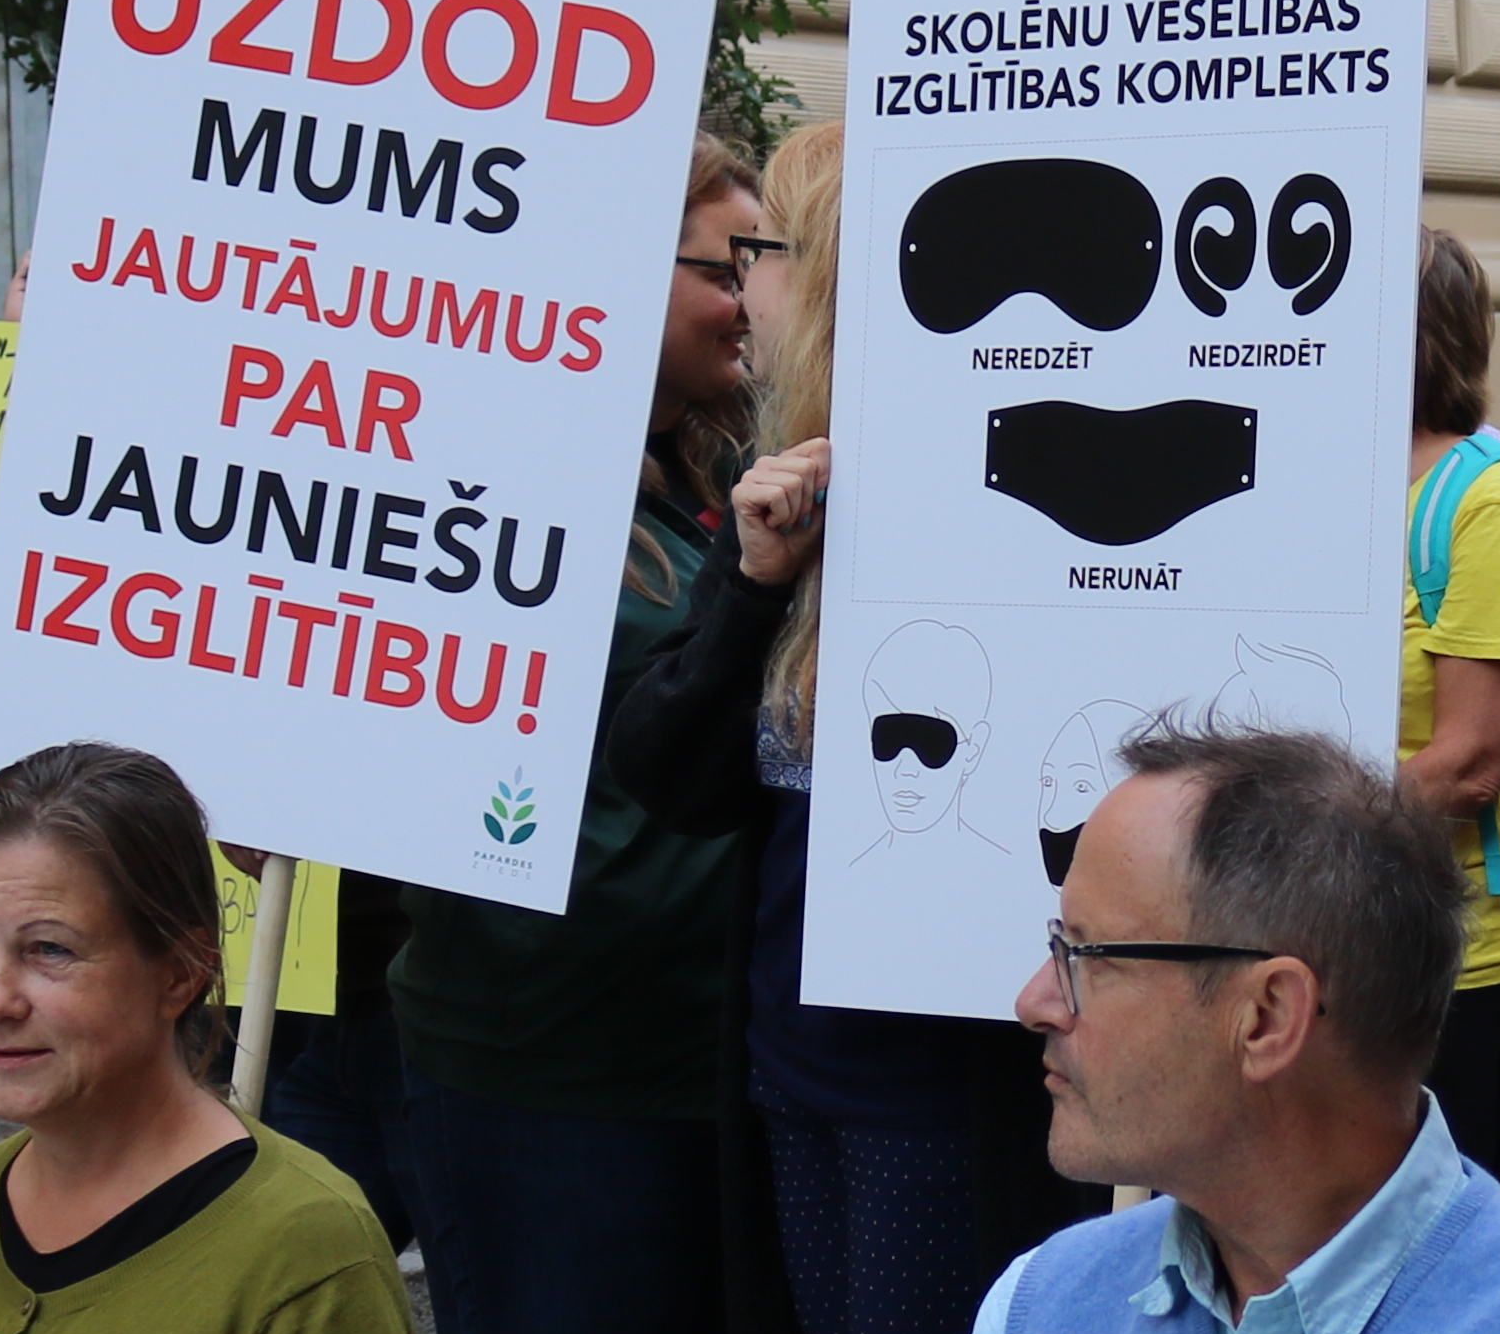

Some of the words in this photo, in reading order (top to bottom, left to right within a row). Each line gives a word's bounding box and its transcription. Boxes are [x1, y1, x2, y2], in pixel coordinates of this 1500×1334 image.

[874, 58, 1103, 119] IZGLĪTĪBAS
[1115, 47, 1392, 107] KOMPLEKTS
[192, 100, 527, 235] MUMS
[71, 217, 610, 374] JAUTĀJUMUS
[971, 341, 1094, 372] NEREDZĒT
[1187, 337, 1326, 369] NEDZIRDĒT
[221, 344, 421, 462] PAR
[38, 434, 567, 609] JAUNIEŠU
[1068, 560, 1183, 593] NERUNĀT
[15, 549, 549, 735] IZGLĪTĪBU!
[472, 861, 531, 880] ZIEDS
[474, 850, 533, 869] PAPARDES
